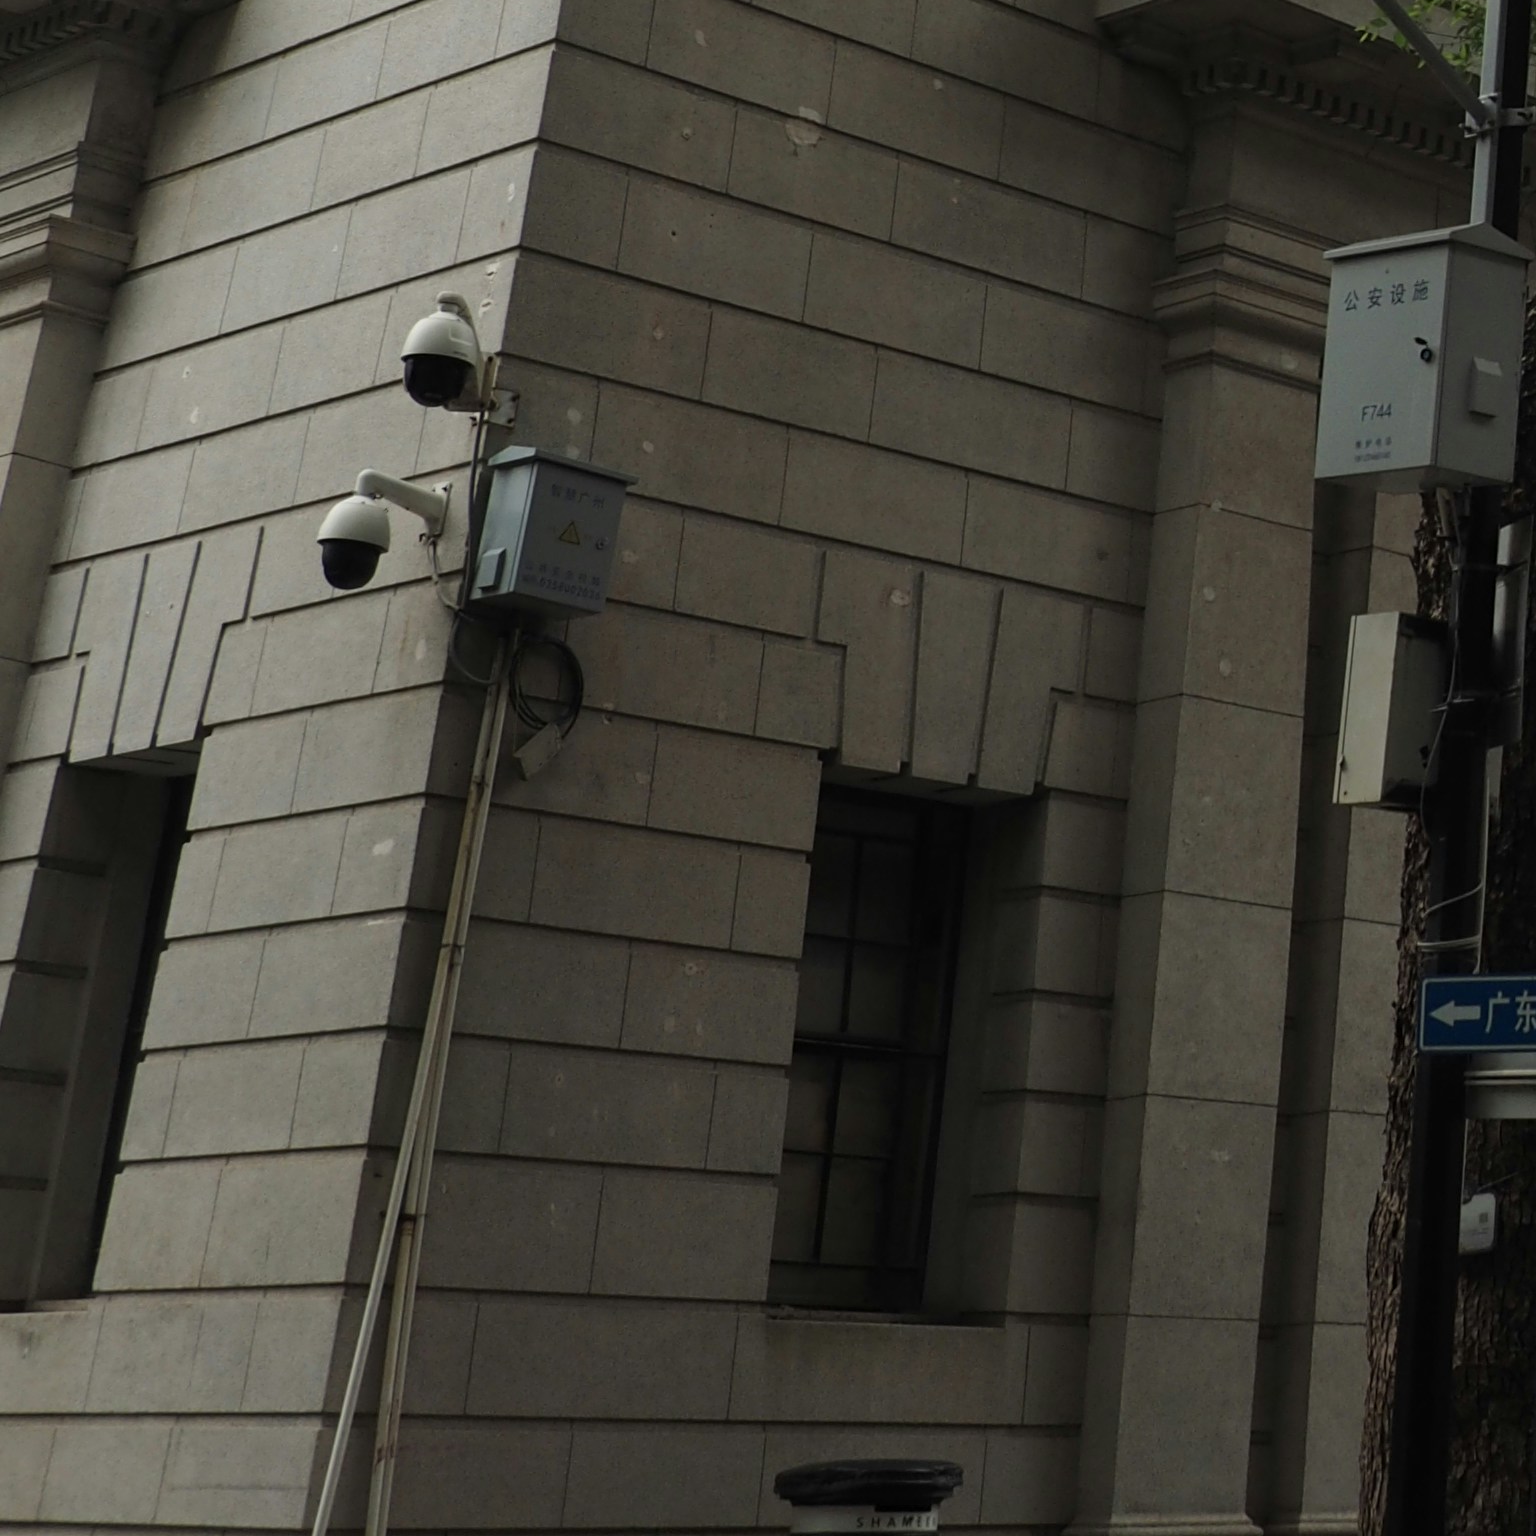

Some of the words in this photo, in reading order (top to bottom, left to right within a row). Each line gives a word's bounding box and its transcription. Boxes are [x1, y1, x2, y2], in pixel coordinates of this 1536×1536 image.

[1344, 279, 1430, 312] 公安设施
[1360, 403, 1393, 423] F744
